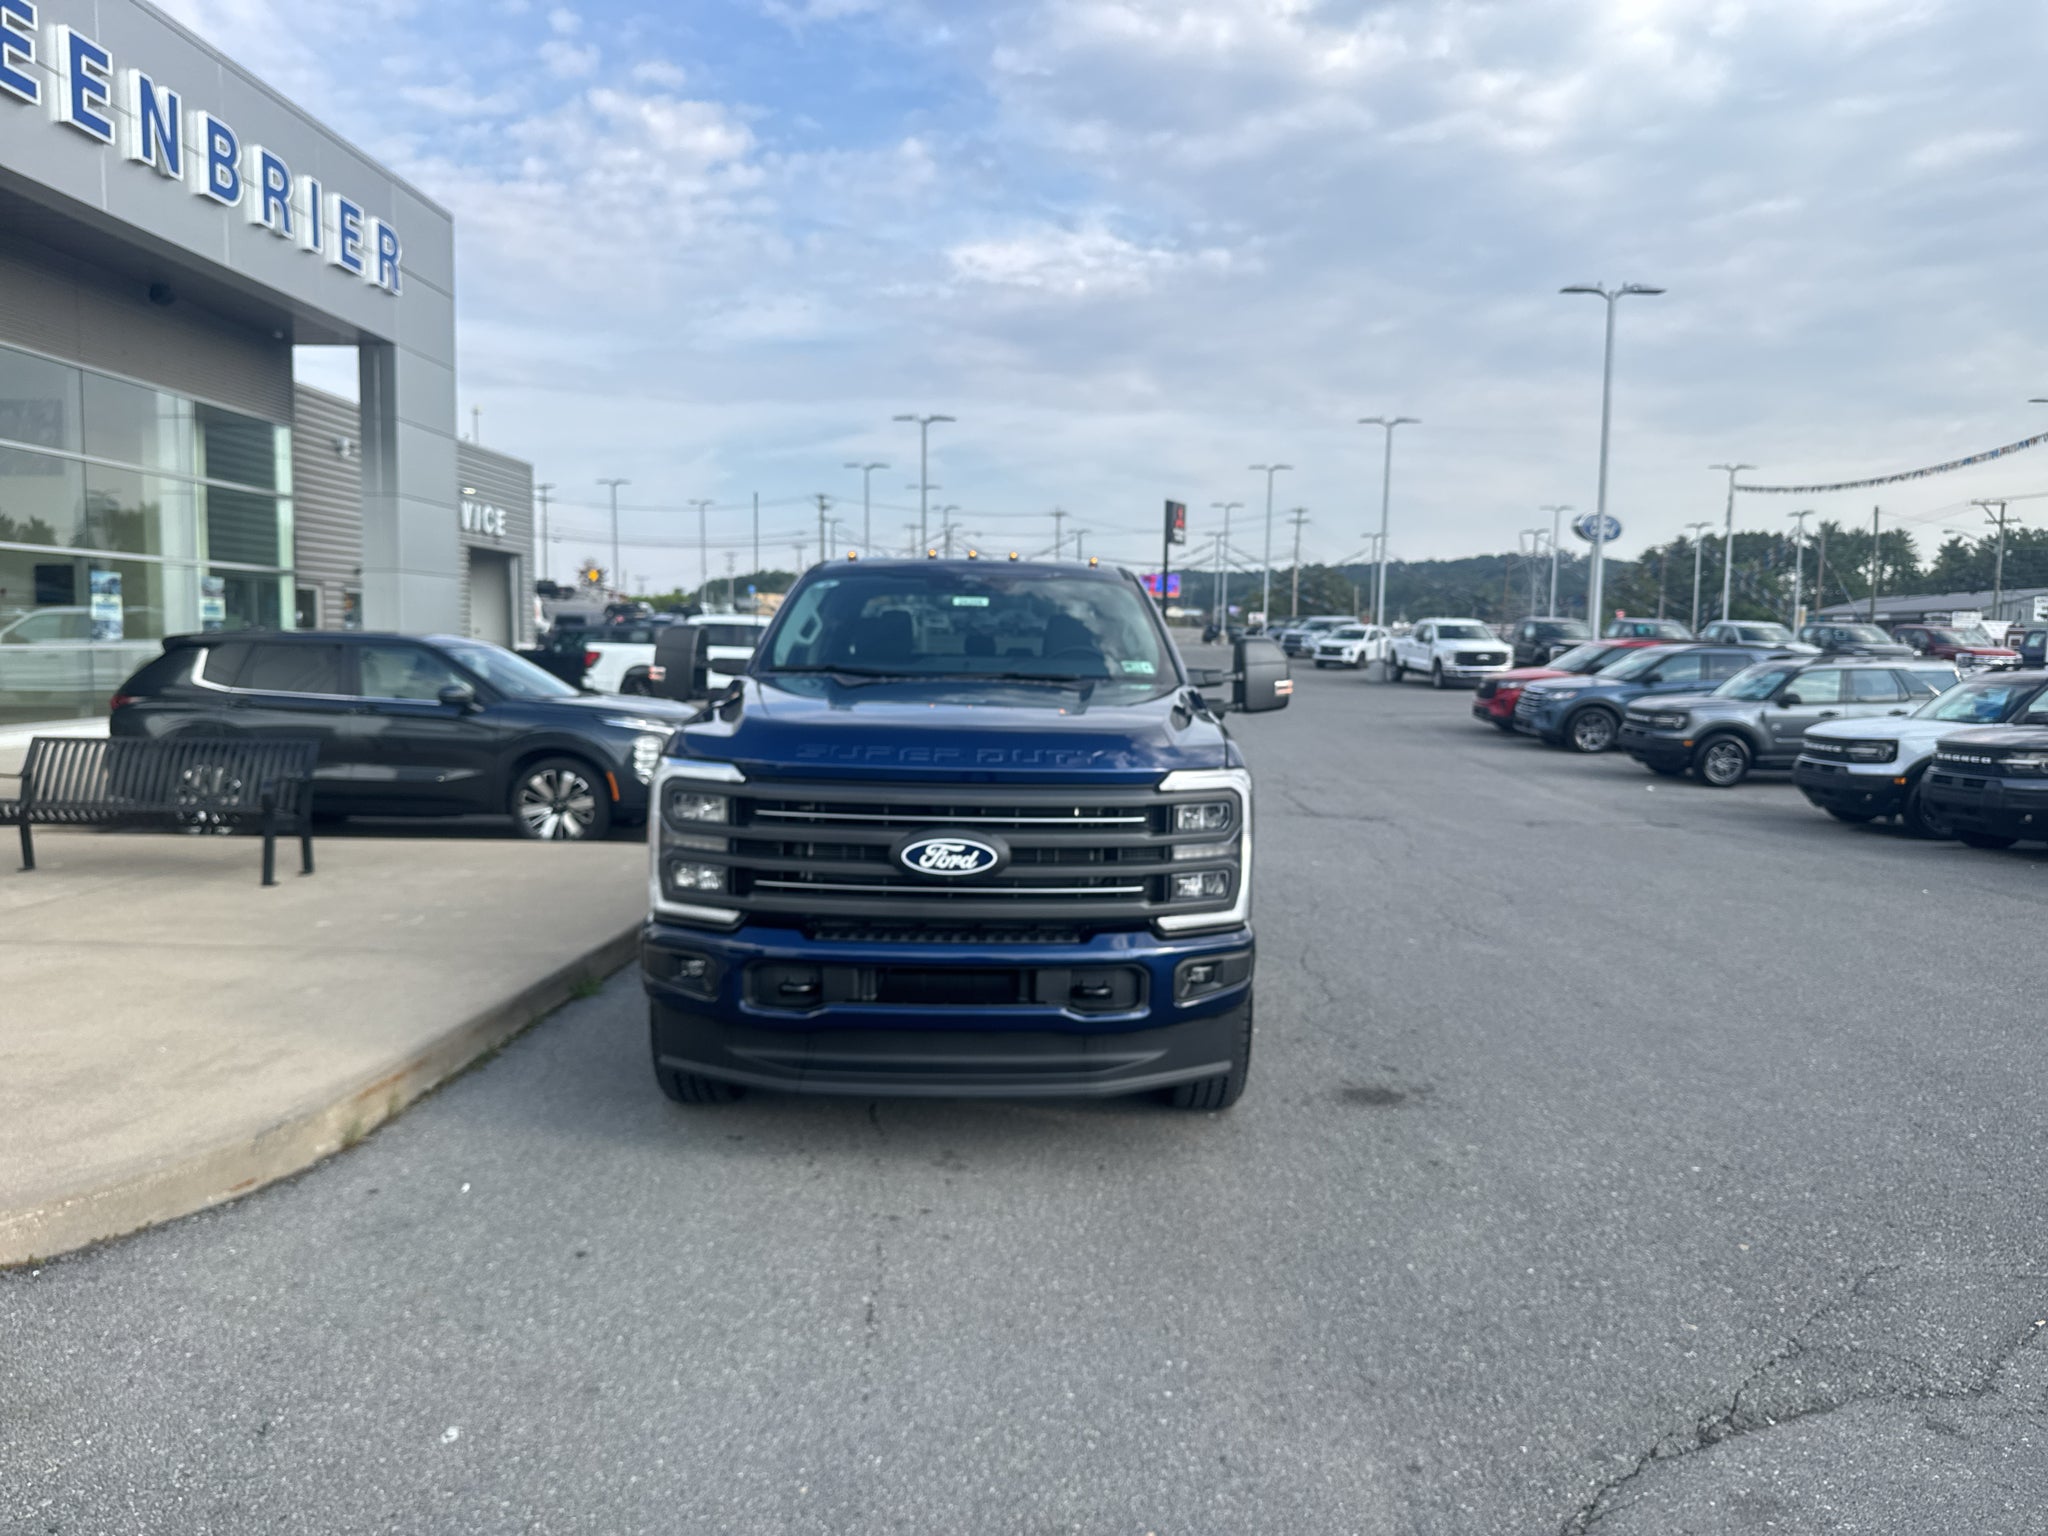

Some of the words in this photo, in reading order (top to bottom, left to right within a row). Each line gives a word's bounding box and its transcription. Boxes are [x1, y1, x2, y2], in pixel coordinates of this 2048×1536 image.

[461, 500, 507, 536] VICE
[795, 743, 961, 763] SUPER
[976, 748, 1104, 766] DUTY
[1936, 752, 1992, 765] BRONCO
[919, 843, 980, 869] Ford
